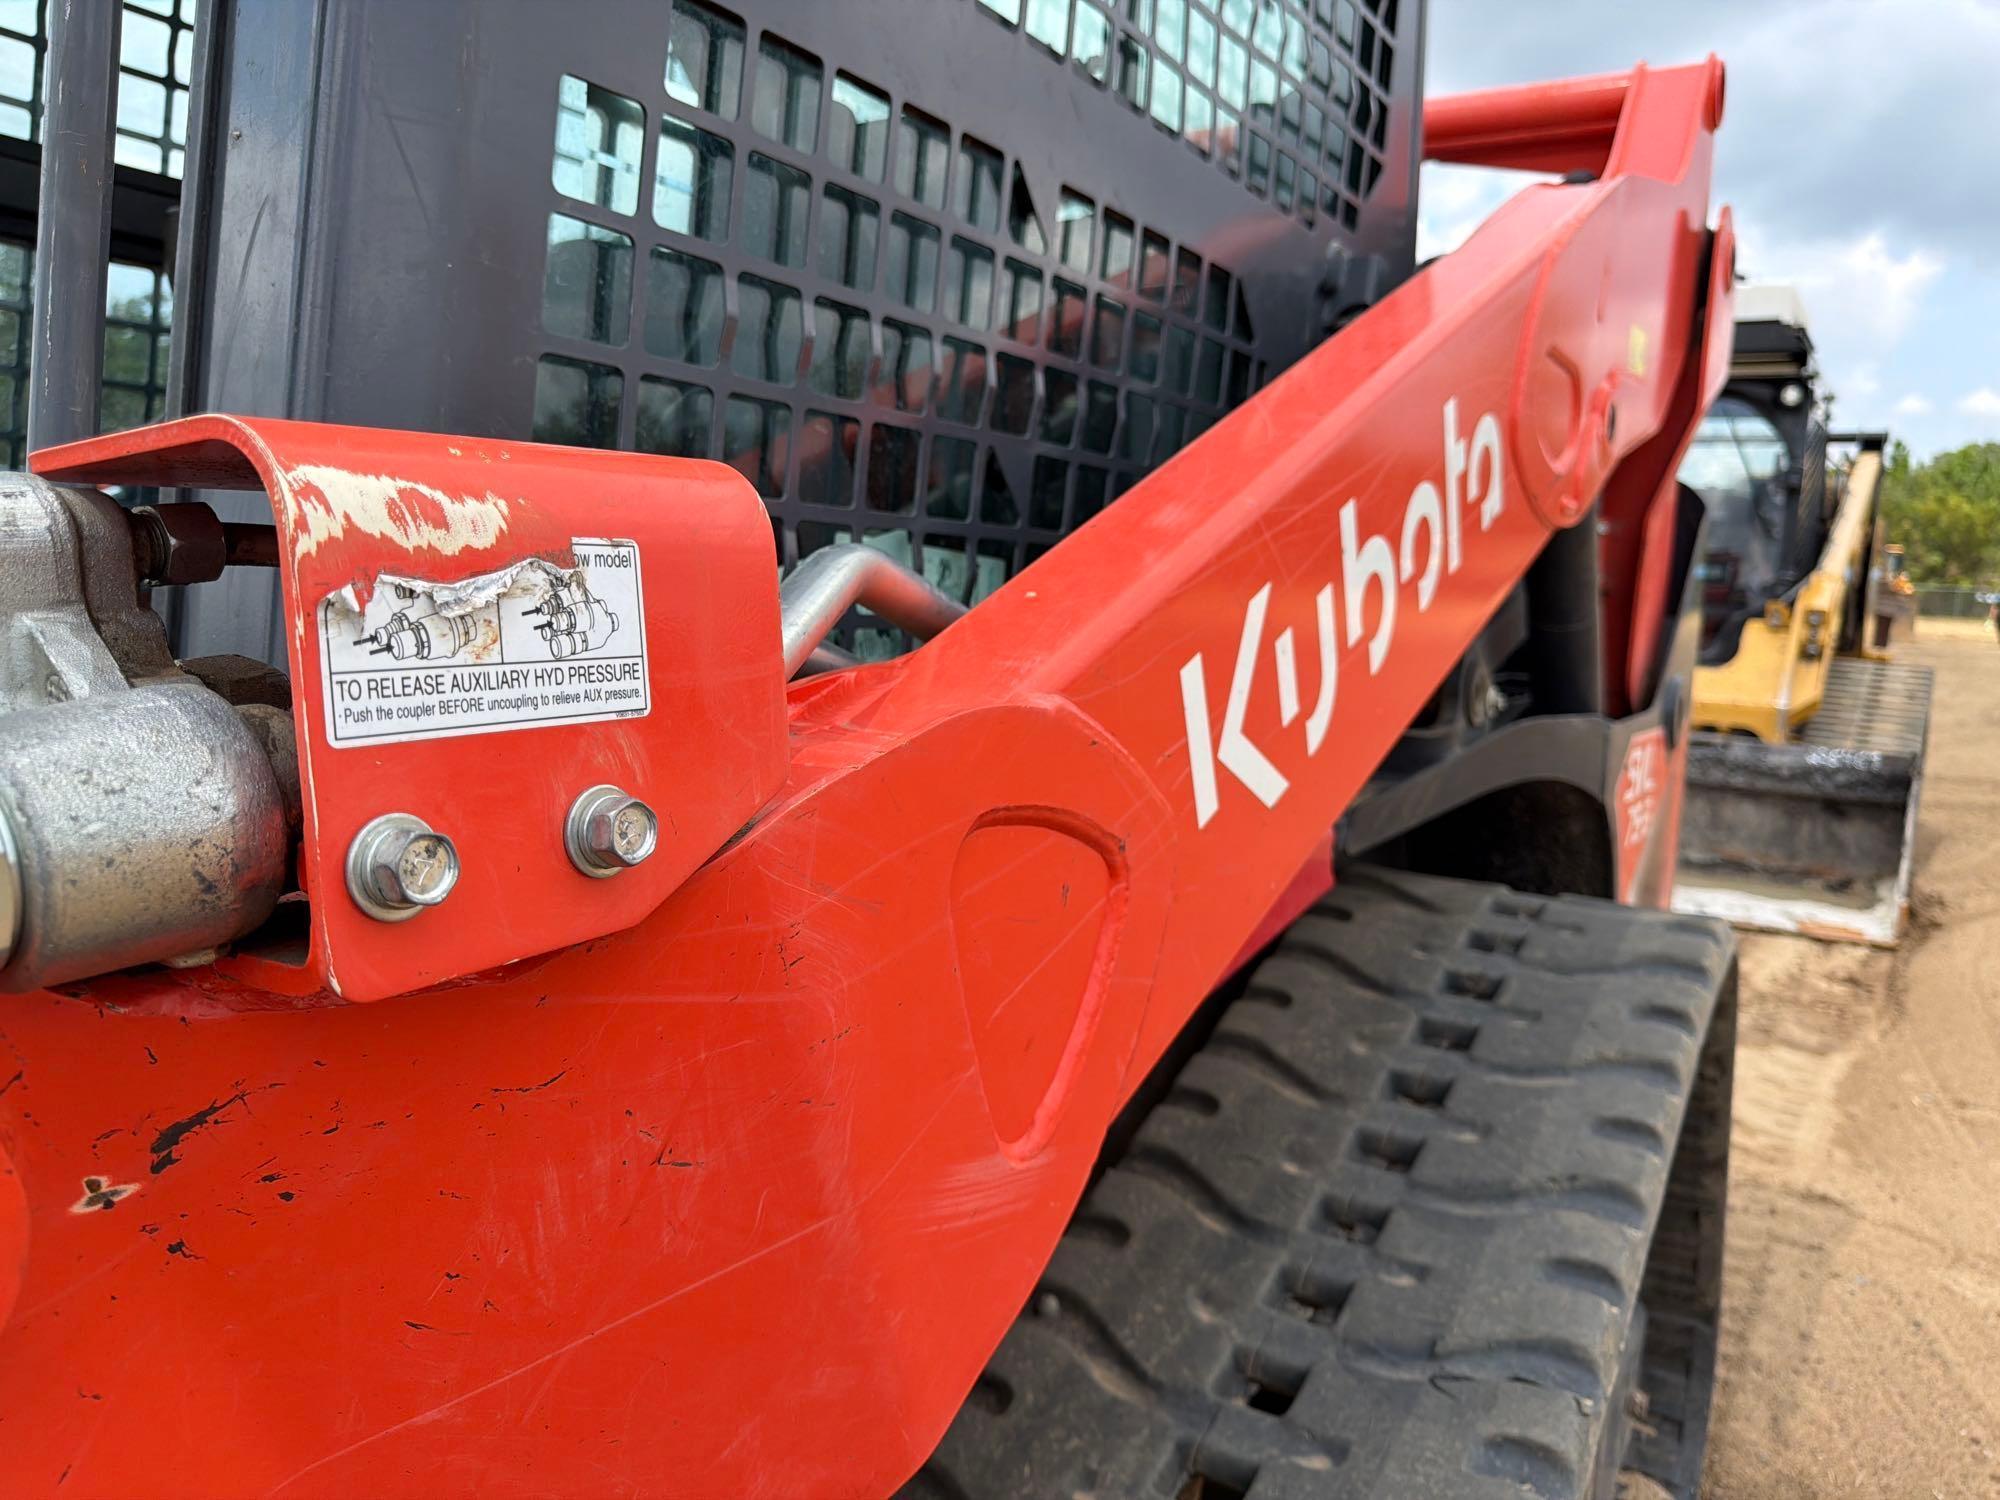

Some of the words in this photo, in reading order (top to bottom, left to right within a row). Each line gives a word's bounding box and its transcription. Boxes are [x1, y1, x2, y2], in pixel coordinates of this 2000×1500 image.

[594, 550, 632, 568] model
[1179, 396, 1504, 829] Kubota
[336, 680, 362, 702] TO
[367, 674, 446, 699] RELEASE
[450, 668, 530, 693] AUXILIARY
[534, 667, 565, 687] HYD
[568, 662, 641, 684] PRESSURE
[376, 704, 394, 721] the
[397, 702, 436, 723] coupler
[439, 697, 485, 715] BEFORE
[487, 693, 539, 712] uncoupling
[541, 692, 550, 703] to
[552, 690, 581, 705] relieve
[584, 687, 603, 703] AUX
[605, 686, 642, 704] pressure.
